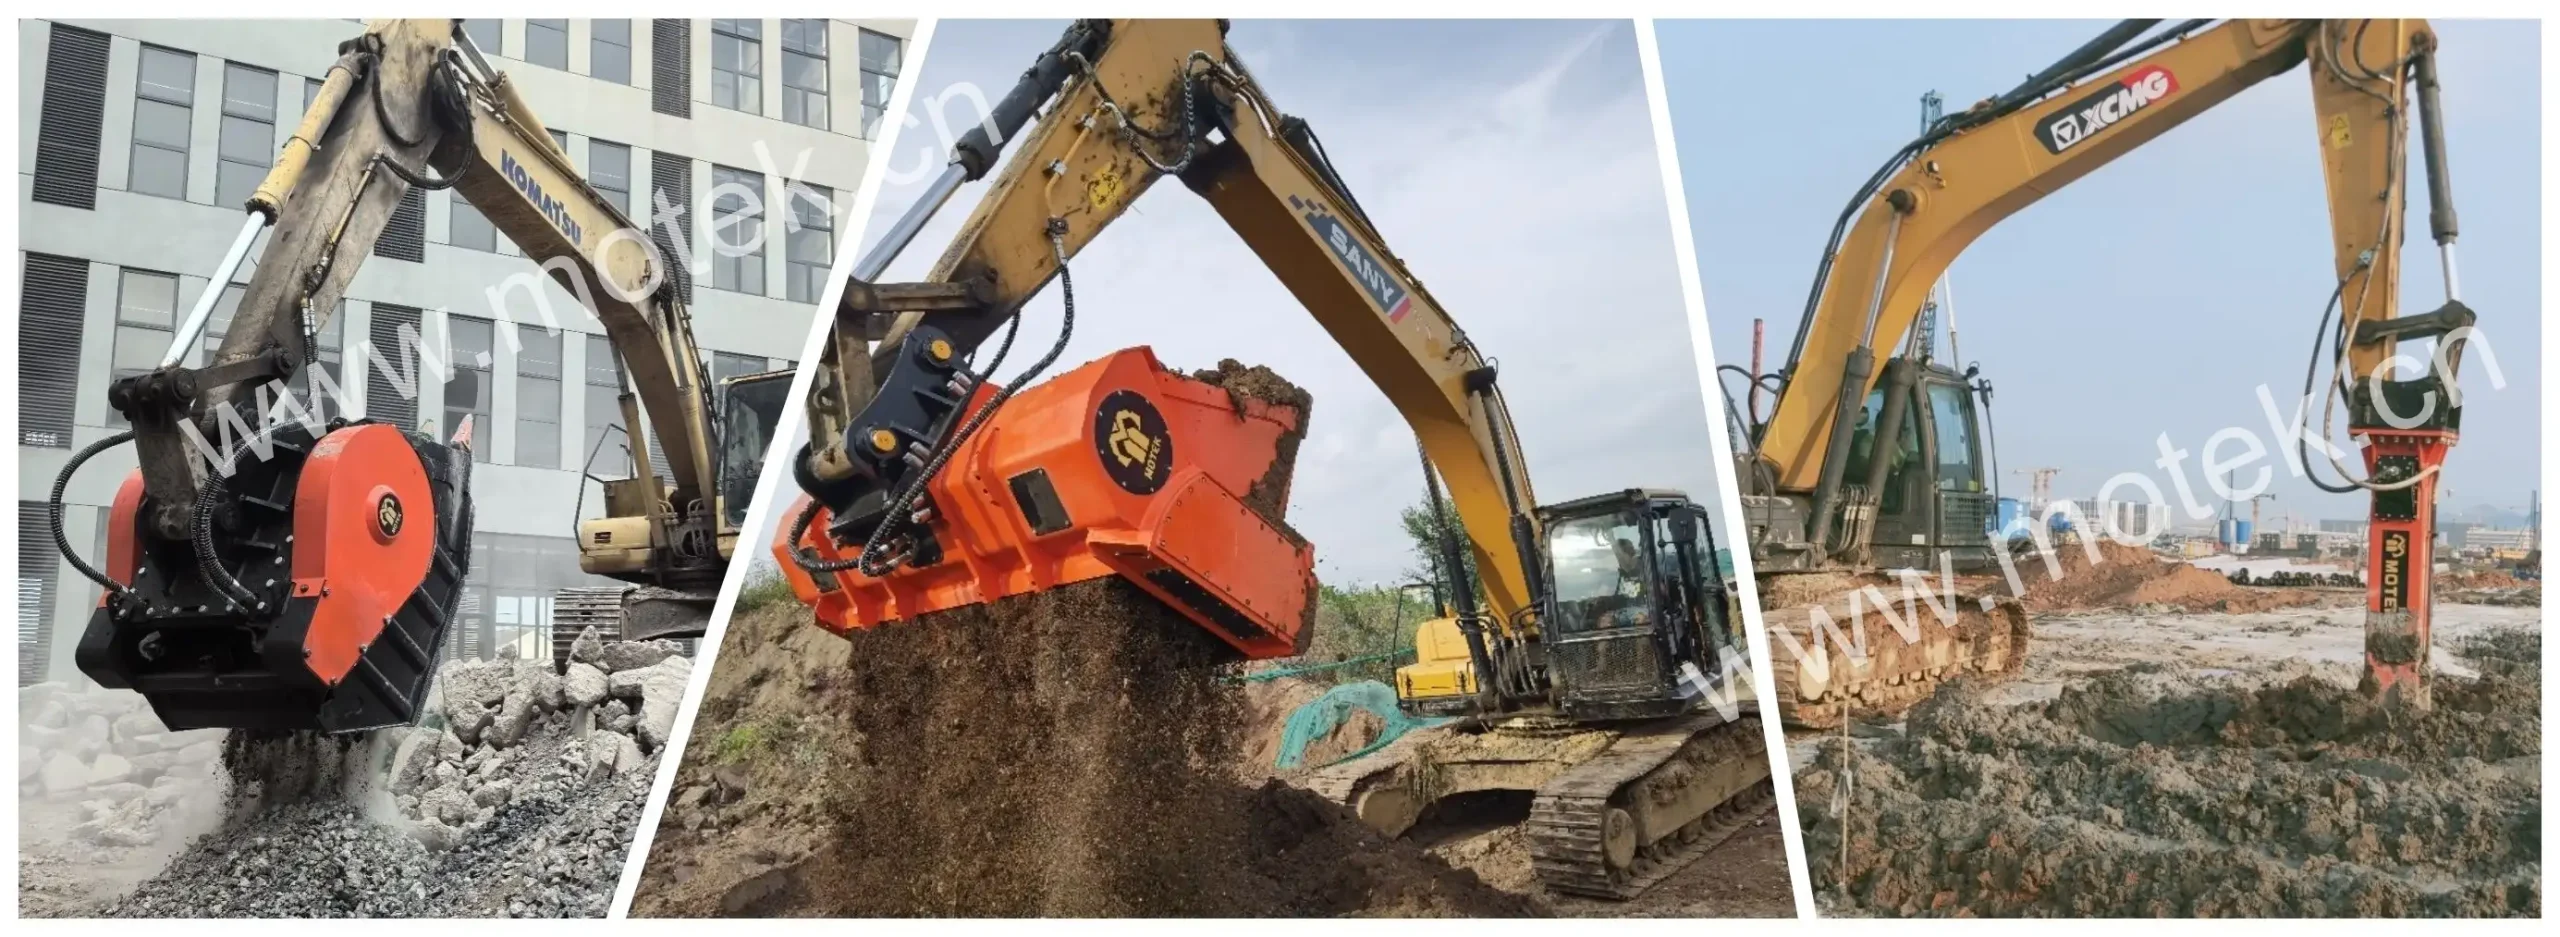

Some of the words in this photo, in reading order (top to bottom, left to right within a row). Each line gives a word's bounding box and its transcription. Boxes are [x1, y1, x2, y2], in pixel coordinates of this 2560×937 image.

[2080, 71, 2169, 138] XCMG
[501, 147, 582, 246] KOMATSU
[1330, 223, 1395, 304] SANY
[1144, 435, 1162, 481] MOTEK
[2384, 560, 2399, 613] MOTE
